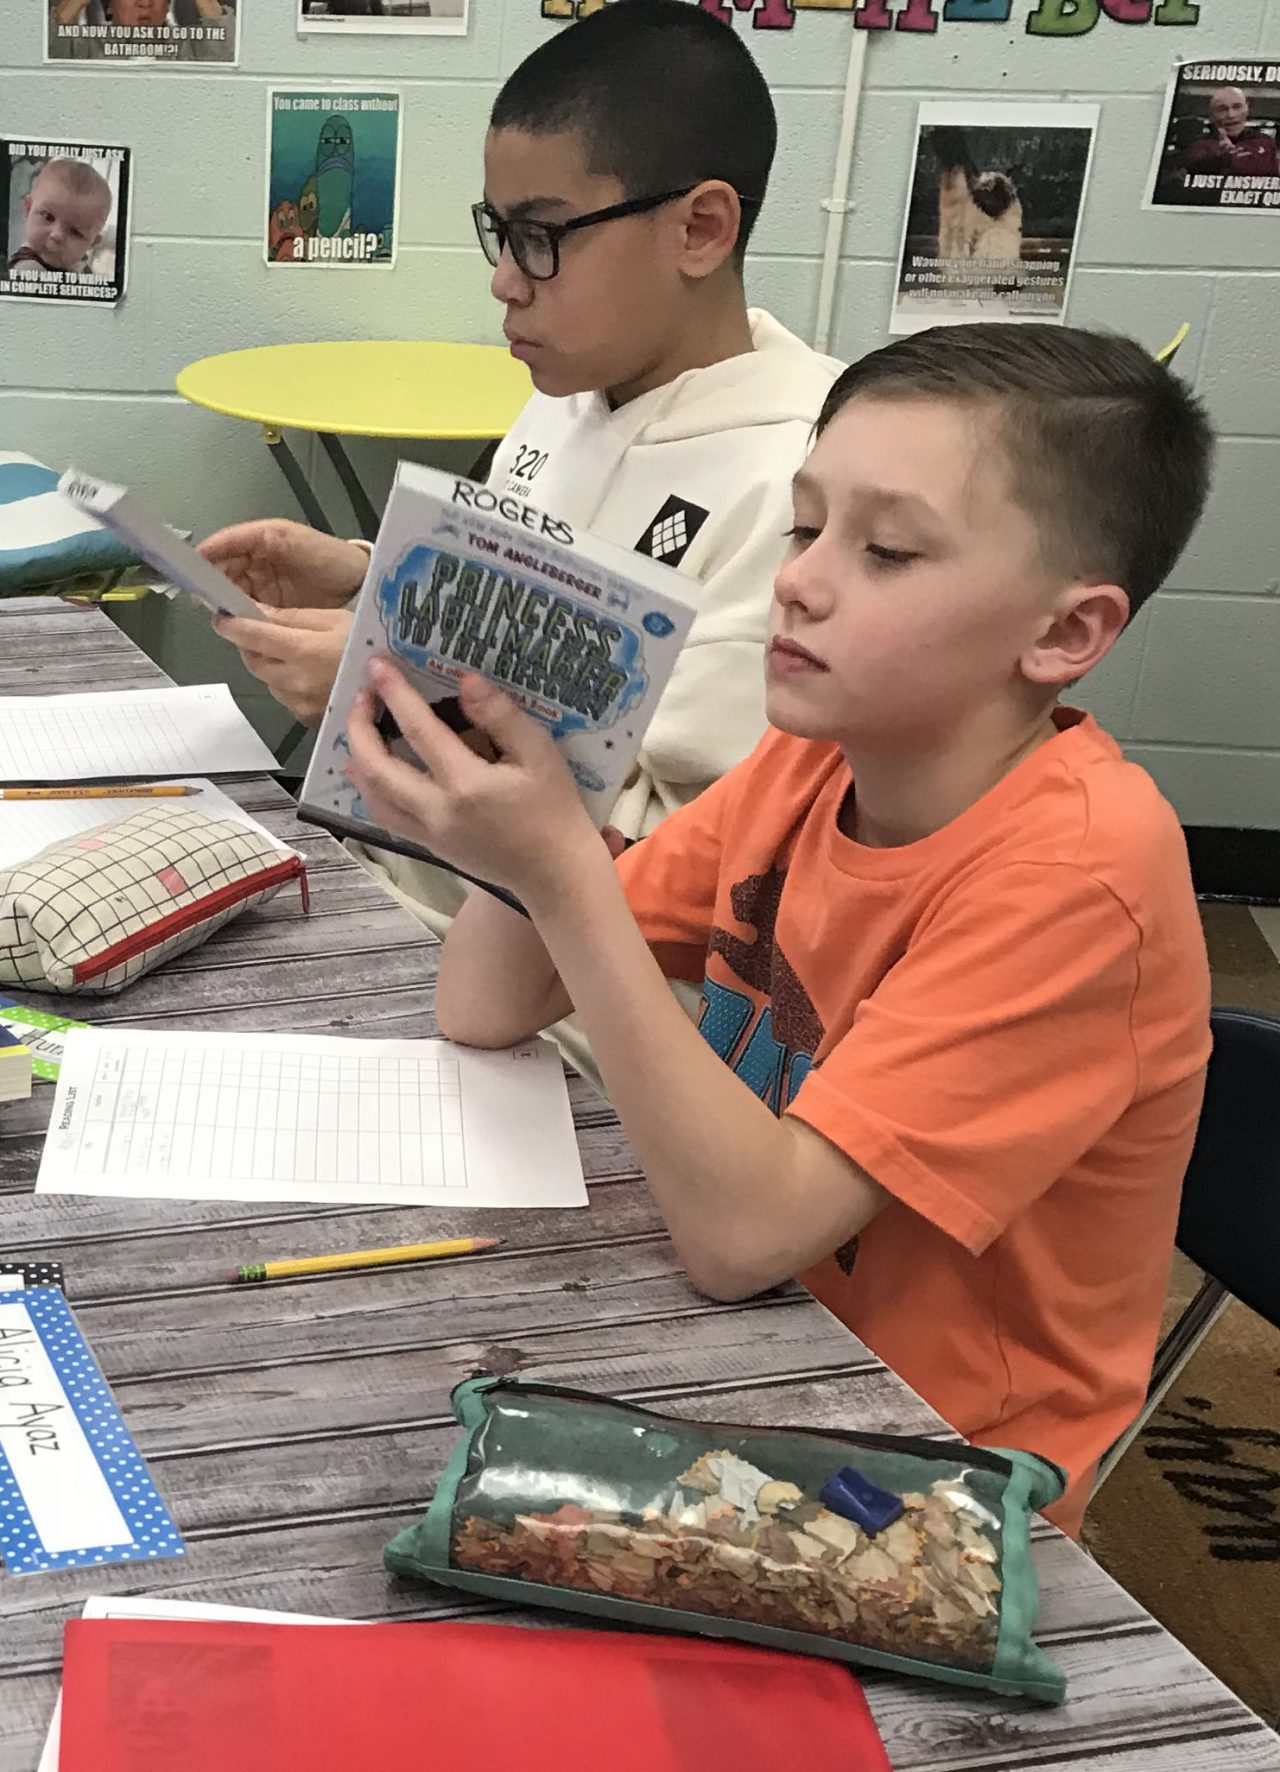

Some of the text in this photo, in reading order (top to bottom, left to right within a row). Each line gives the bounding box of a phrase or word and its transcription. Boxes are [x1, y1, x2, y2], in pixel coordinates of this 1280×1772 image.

[58, 25, 226, 40] AND NOW YOU ASK TO GO TO THE
[1183, 65, 1263, 82] SERIOUSLY,
[273, 96, 398, 112] You came to class without
[8, 143, 125, 161] DID YOU REALLY JUST ASK
[1184, 174, 1190, 188] I
[1191, 174, 1224, 189] JUST
[1220, 190, 1262, 205] EXACT
[293, 232, 378, 260] a pencil?
[10, 269, 18, 280] IF
[19, 270, 38, 282] YOU
[40, 271, 63, 283] HAVE
[65, 272, 78, 284] TO
[0, 280, 118, 299] IN COMPLETE SENTENCES?
[509, 443, 549, 481] 320
[452, 481, 575, 545] ROGERS
[468, 532, 499, 556] TOM
[431, 553, 622, 663] PRINCESS
[399, 580, 628, 704] LABELMAKER
[64, 1085, 79, 1100] LIST
[58, 1100, 75, 1130] READING
